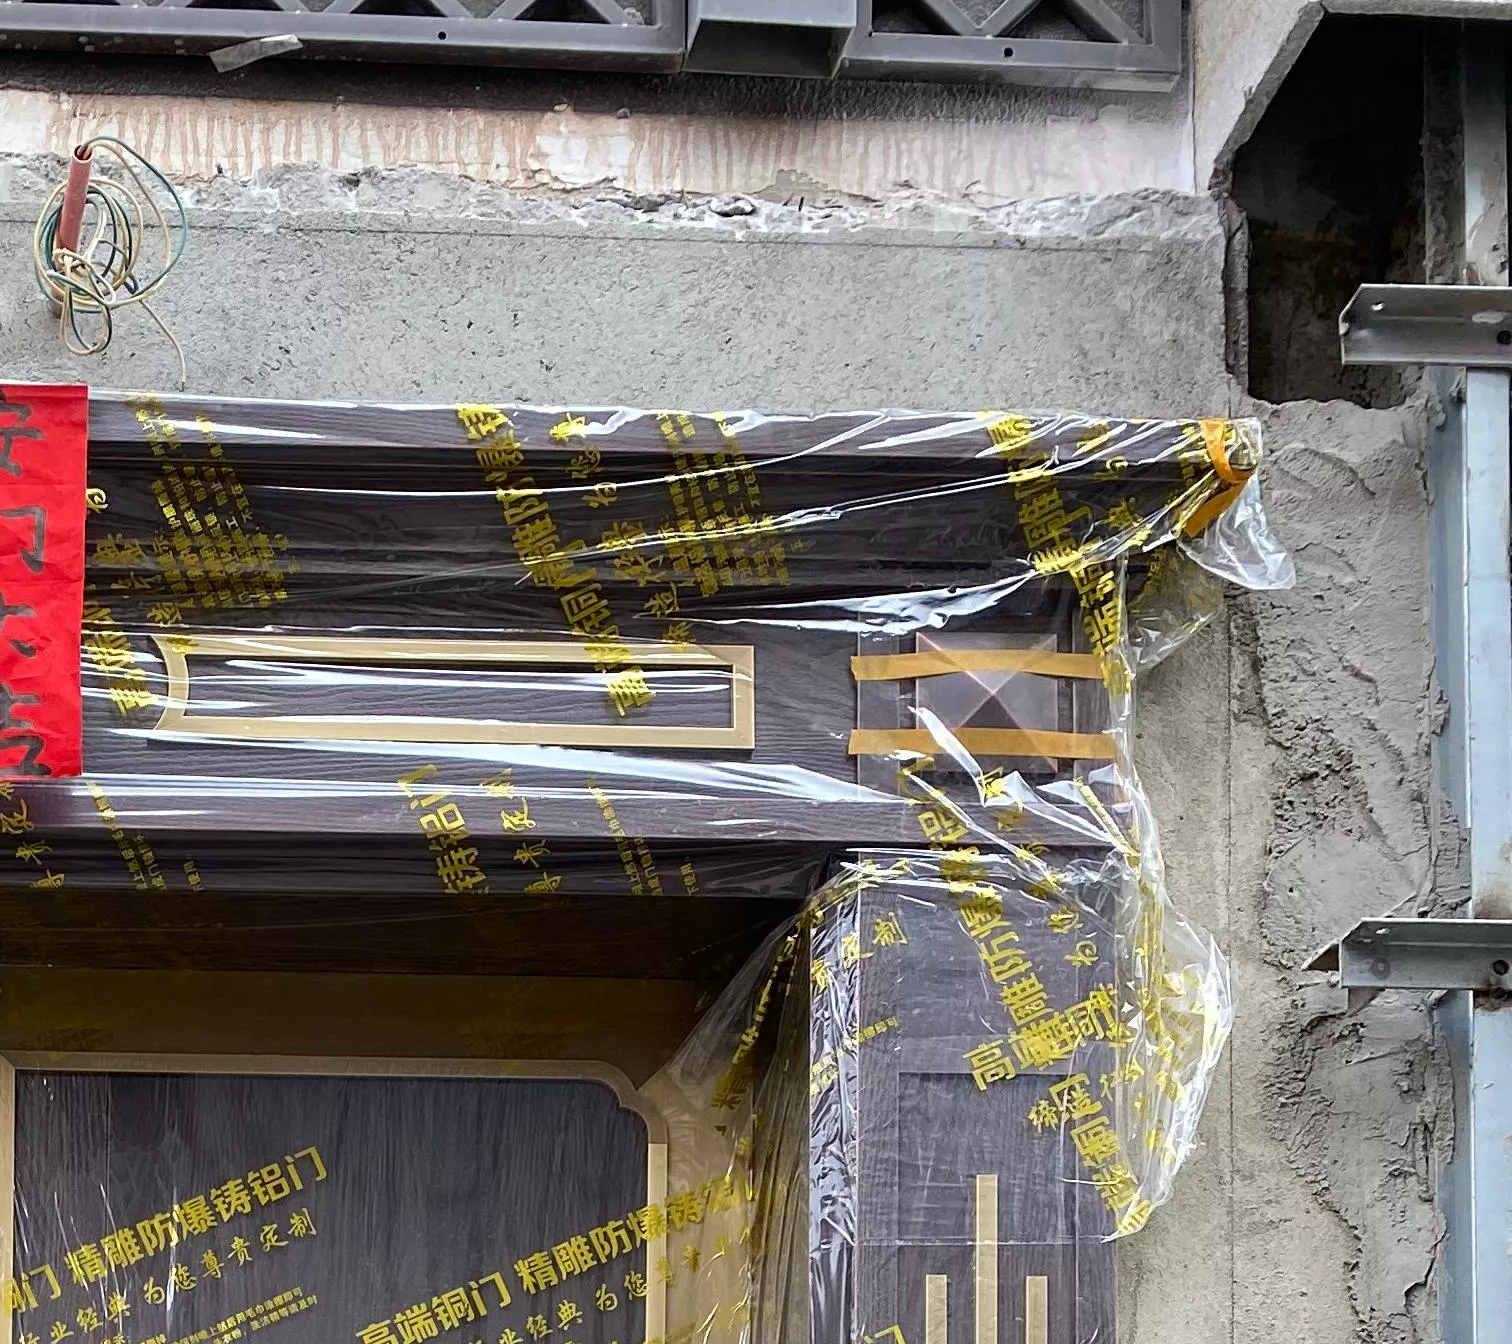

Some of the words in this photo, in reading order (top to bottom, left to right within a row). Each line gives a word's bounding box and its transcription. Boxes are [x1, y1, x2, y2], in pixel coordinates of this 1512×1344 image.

[63, 1146, 328, 1287] 精雕防爆铸铝门
[142, 1209, 318, 1304] 为您尊贵定制
